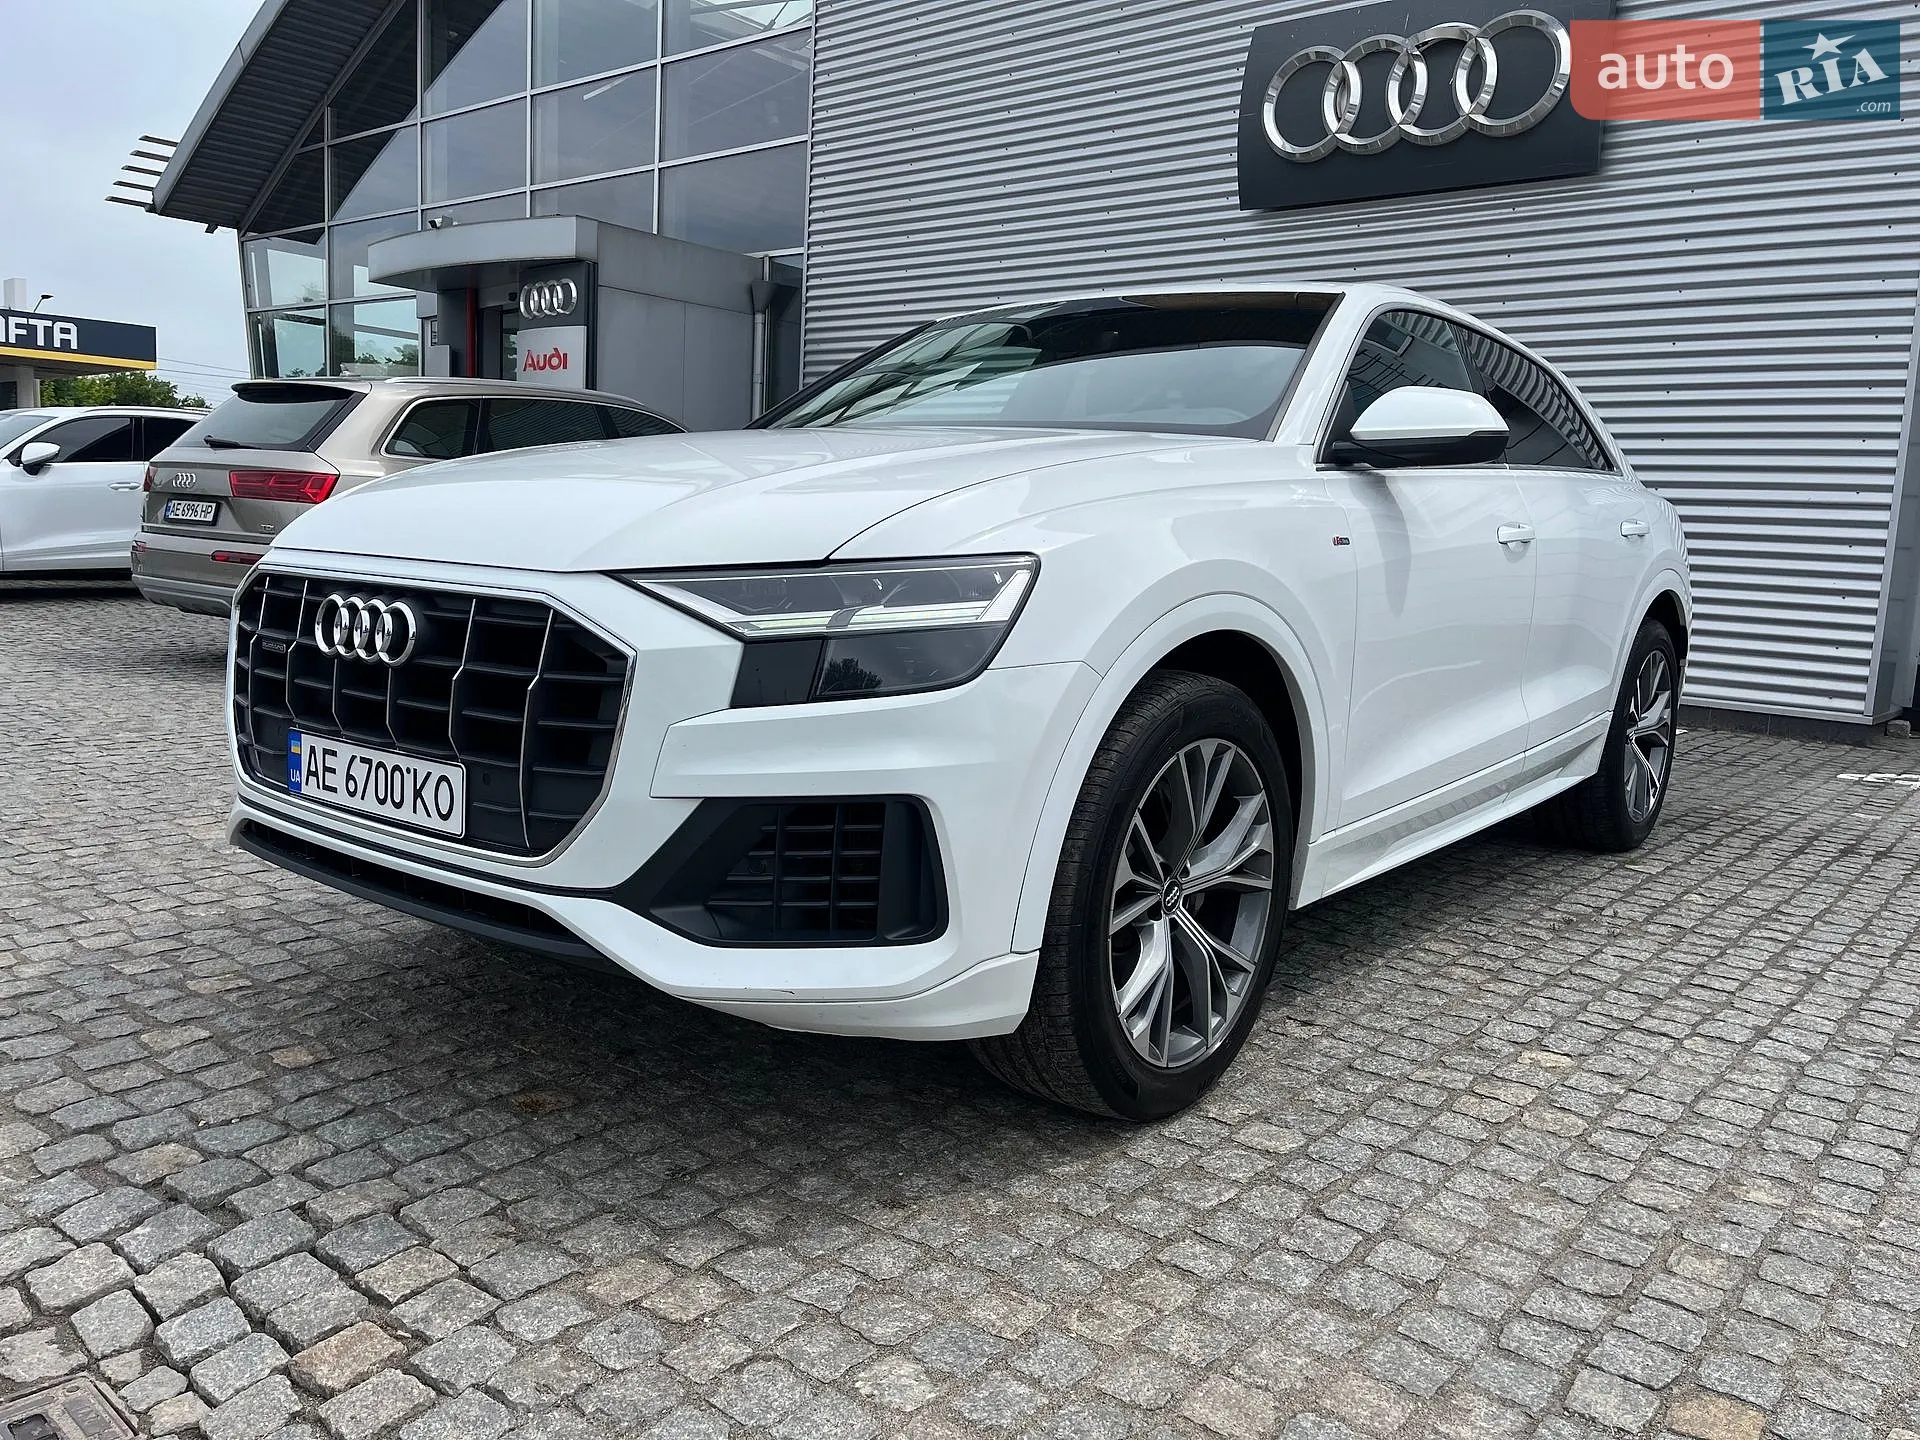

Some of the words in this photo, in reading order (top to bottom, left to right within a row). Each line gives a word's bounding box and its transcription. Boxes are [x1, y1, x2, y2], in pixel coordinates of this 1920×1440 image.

[0, 314, 78, 350] FTA
[169, 501, 182, 517] AE
[181, 502, 199, 518] 6996
[199, 503, 213, 519] HP
[290, 769, 301, 783] UA
[305, 744, 338, 794] AE
[345, 754, 405, 810] 6700
[412, 767, 455, 822] KO
